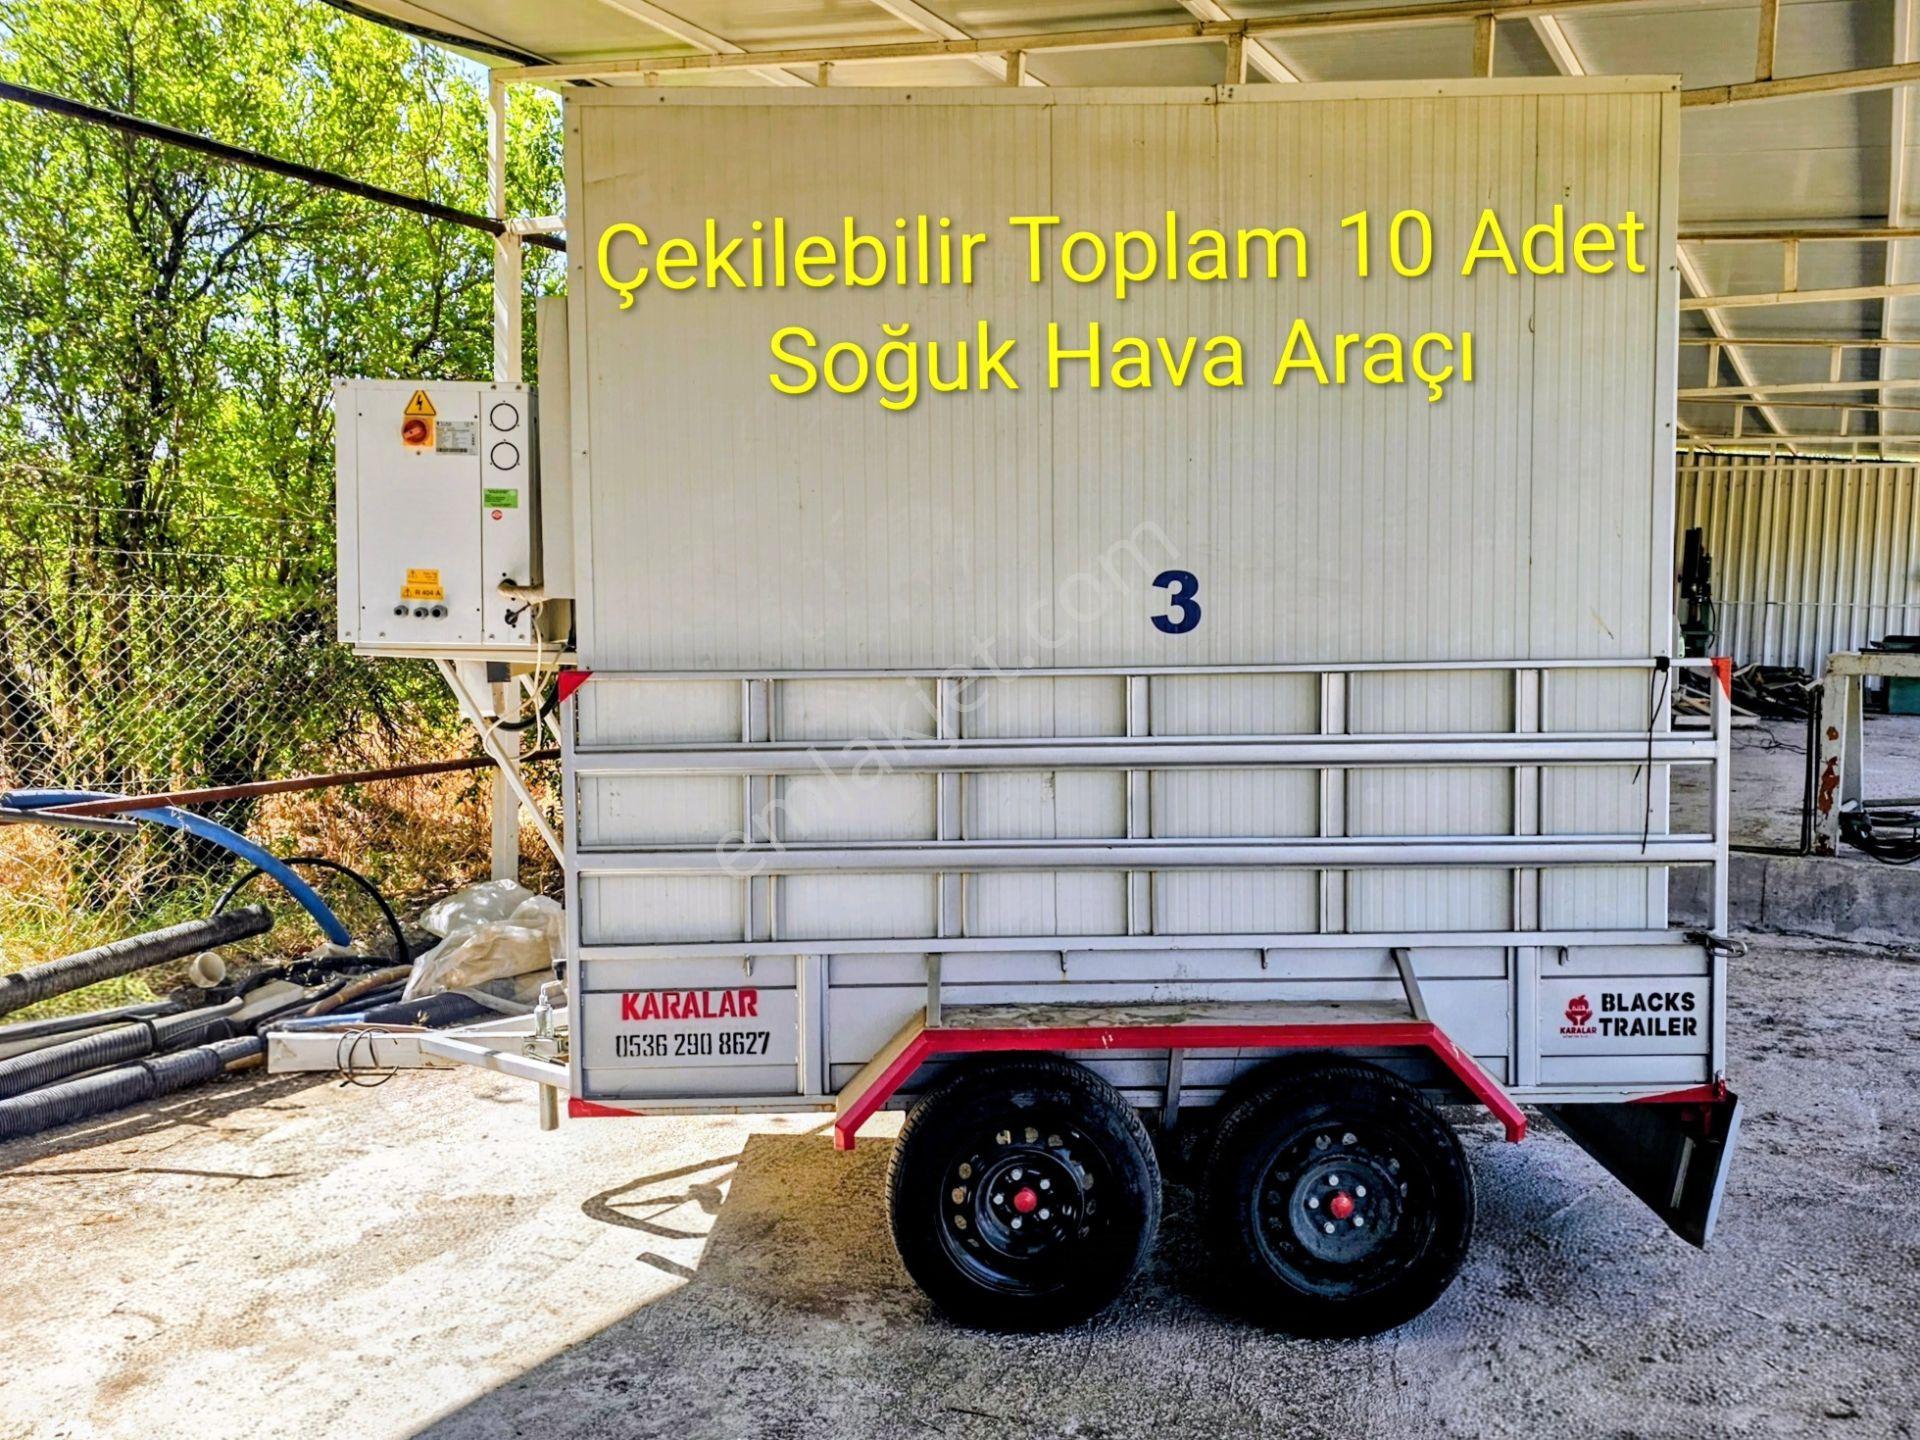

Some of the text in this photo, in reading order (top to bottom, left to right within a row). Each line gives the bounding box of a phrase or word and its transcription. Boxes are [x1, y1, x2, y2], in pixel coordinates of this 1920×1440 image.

[1150, 569, 1202, 635] 3
[621, 988, 758, 1021] KARALAR
[1601, 992, 1695, 1012] BLACKS
[1560, 1026, 1597, 1034] KARALAR
[1599, 1017, 1697, 1036] TRAILER
[615, 1031, 770, 1057] 0536 290 8627
